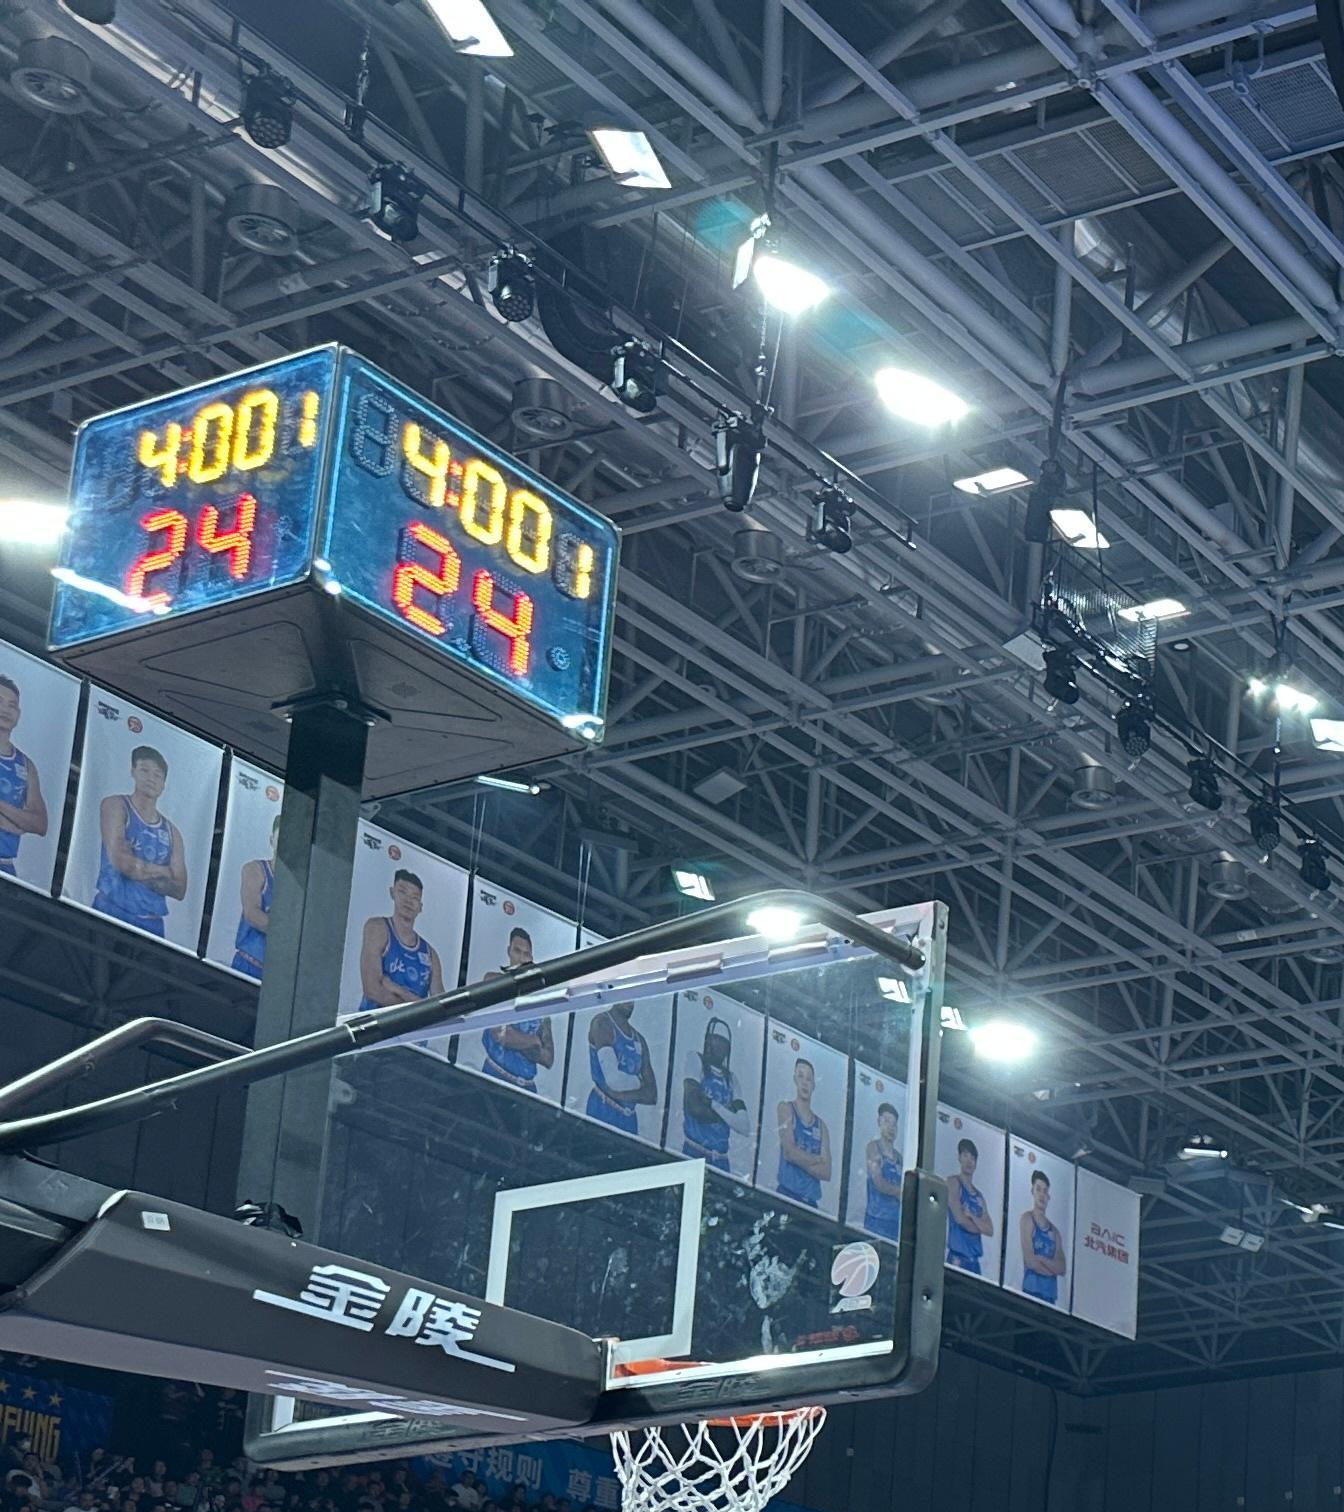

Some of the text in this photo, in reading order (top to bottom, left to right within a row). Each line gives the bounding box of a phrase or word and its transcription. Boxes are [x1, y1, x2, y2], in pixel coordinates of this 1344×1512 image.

[124, 492, 257, 613] 24
[393, 518, 534, 678] 24
[252, 1264, 516, 1373] 金陵
